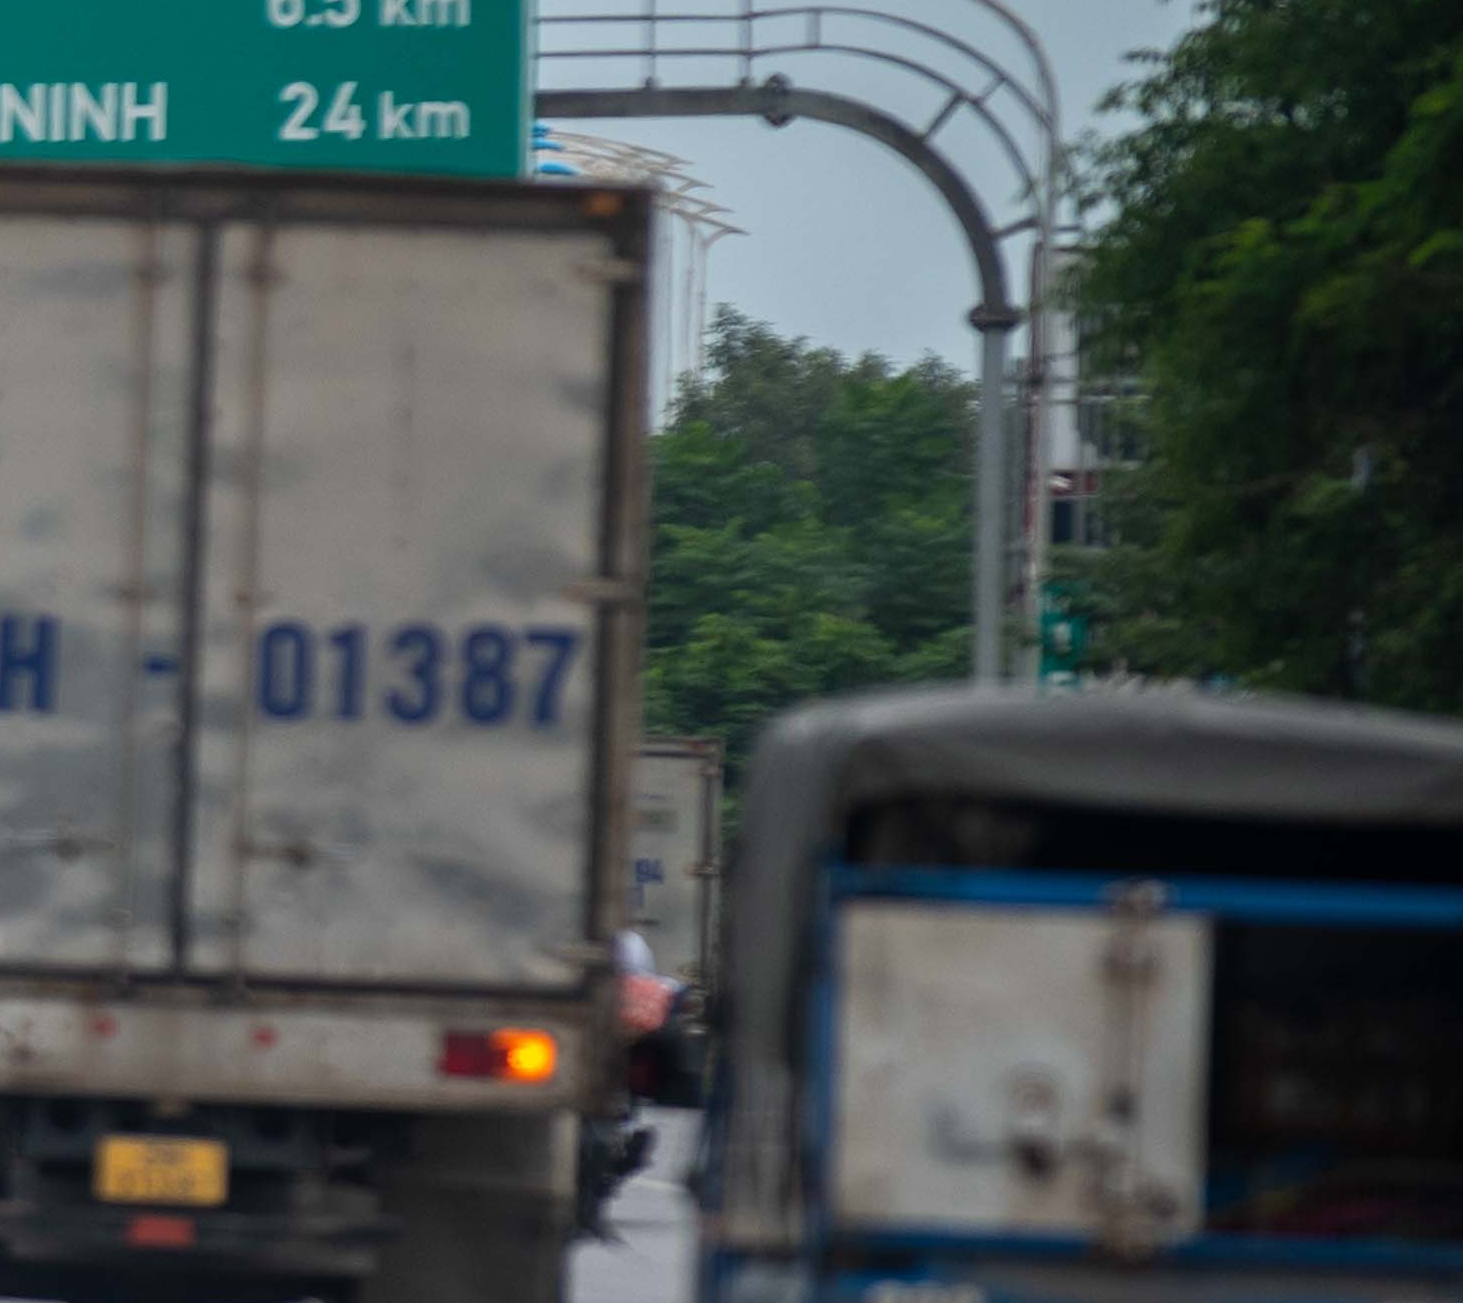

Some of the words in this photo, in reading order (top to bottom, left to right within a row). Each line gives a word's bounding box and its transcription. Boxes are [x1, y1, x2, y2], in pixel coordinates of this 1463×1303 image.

[278, 81, 366, 142] 24
[378, 90, 471, 139] km
[252, 619, 583, 728] 01387
